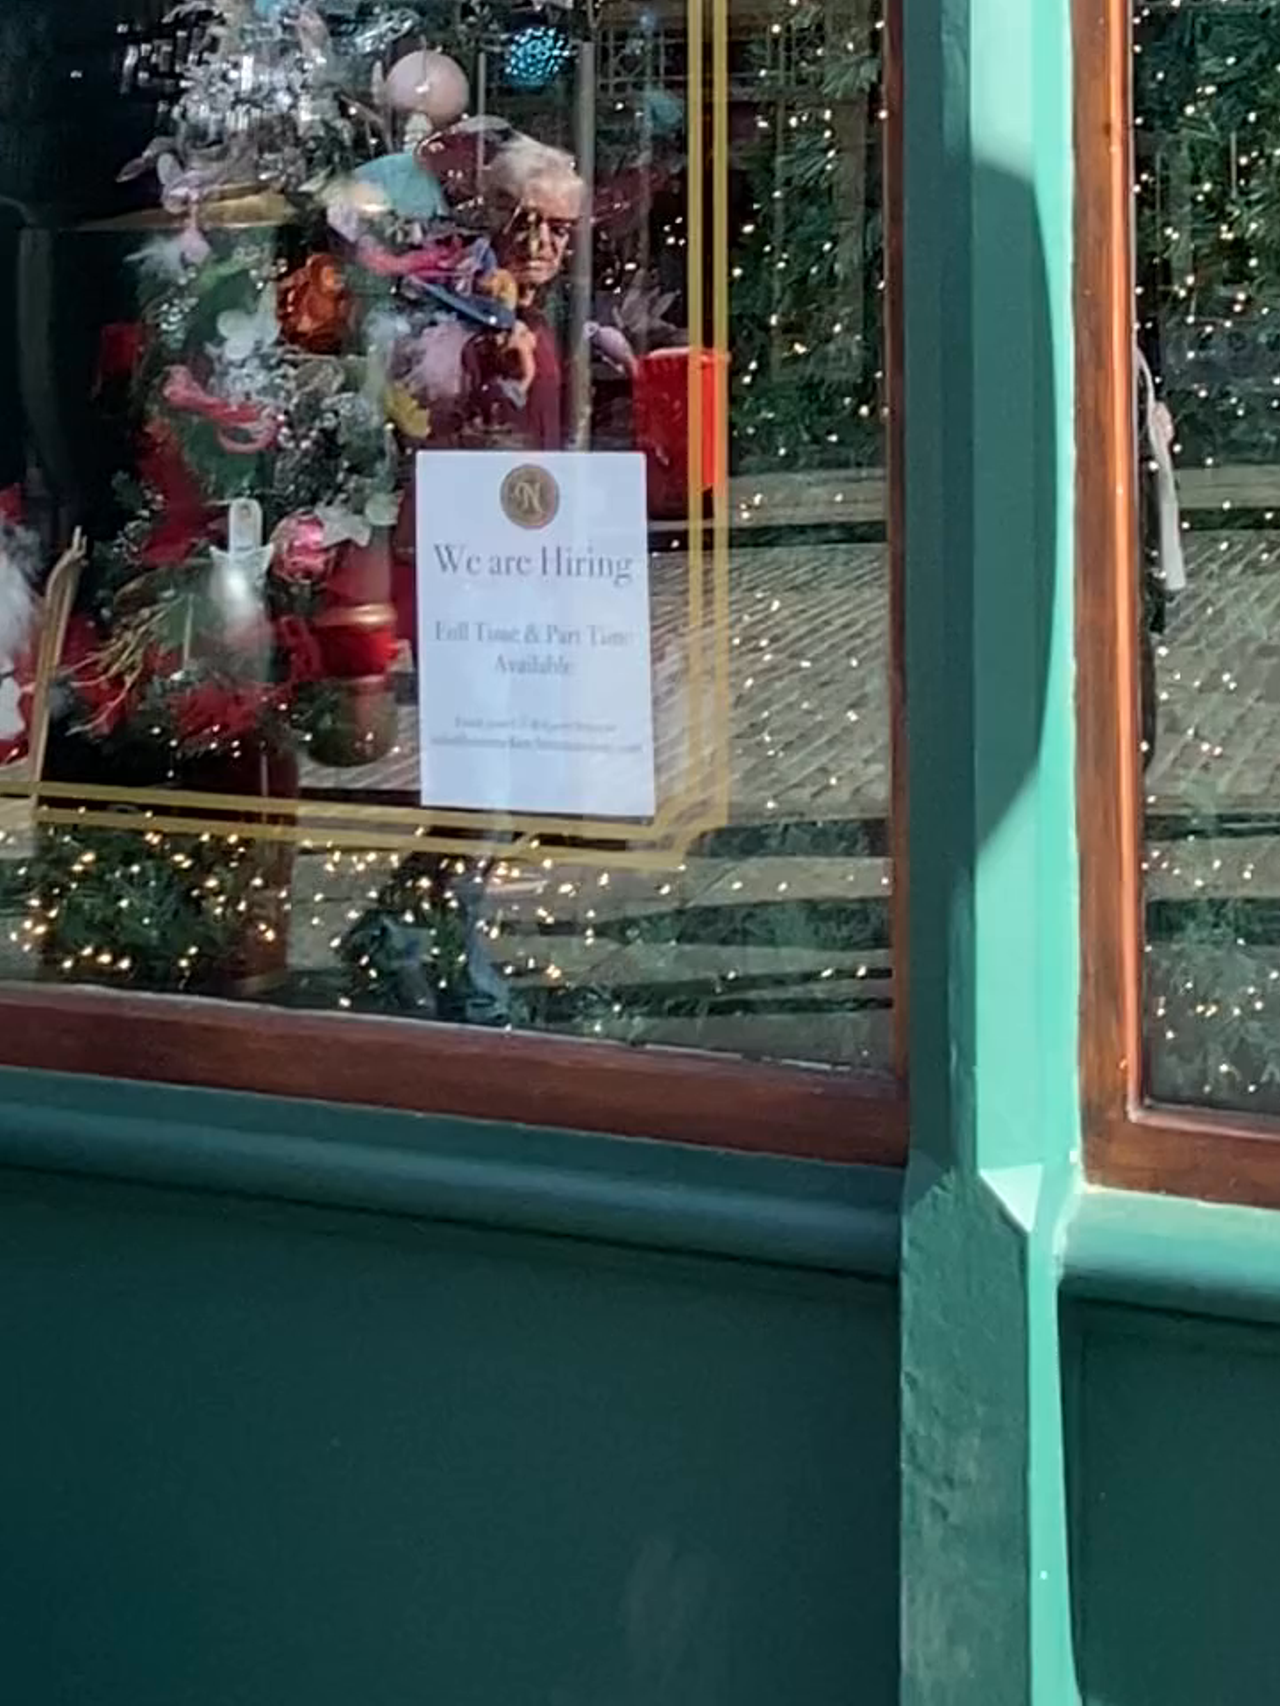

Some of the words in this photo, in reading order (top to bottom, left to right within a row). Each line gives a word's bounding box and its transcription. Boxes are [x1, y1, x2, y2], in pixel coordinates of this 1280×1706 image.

[434, 542, 482, 577] We
[488, 555, 533, 577] are
[540, 540, 636, 587] Hiring
[475, 621, 520, 644] Time
[523, 622, 540, 645] &
[546, 624, 581, 646] Part
[494, 653, 575, 676] Available
